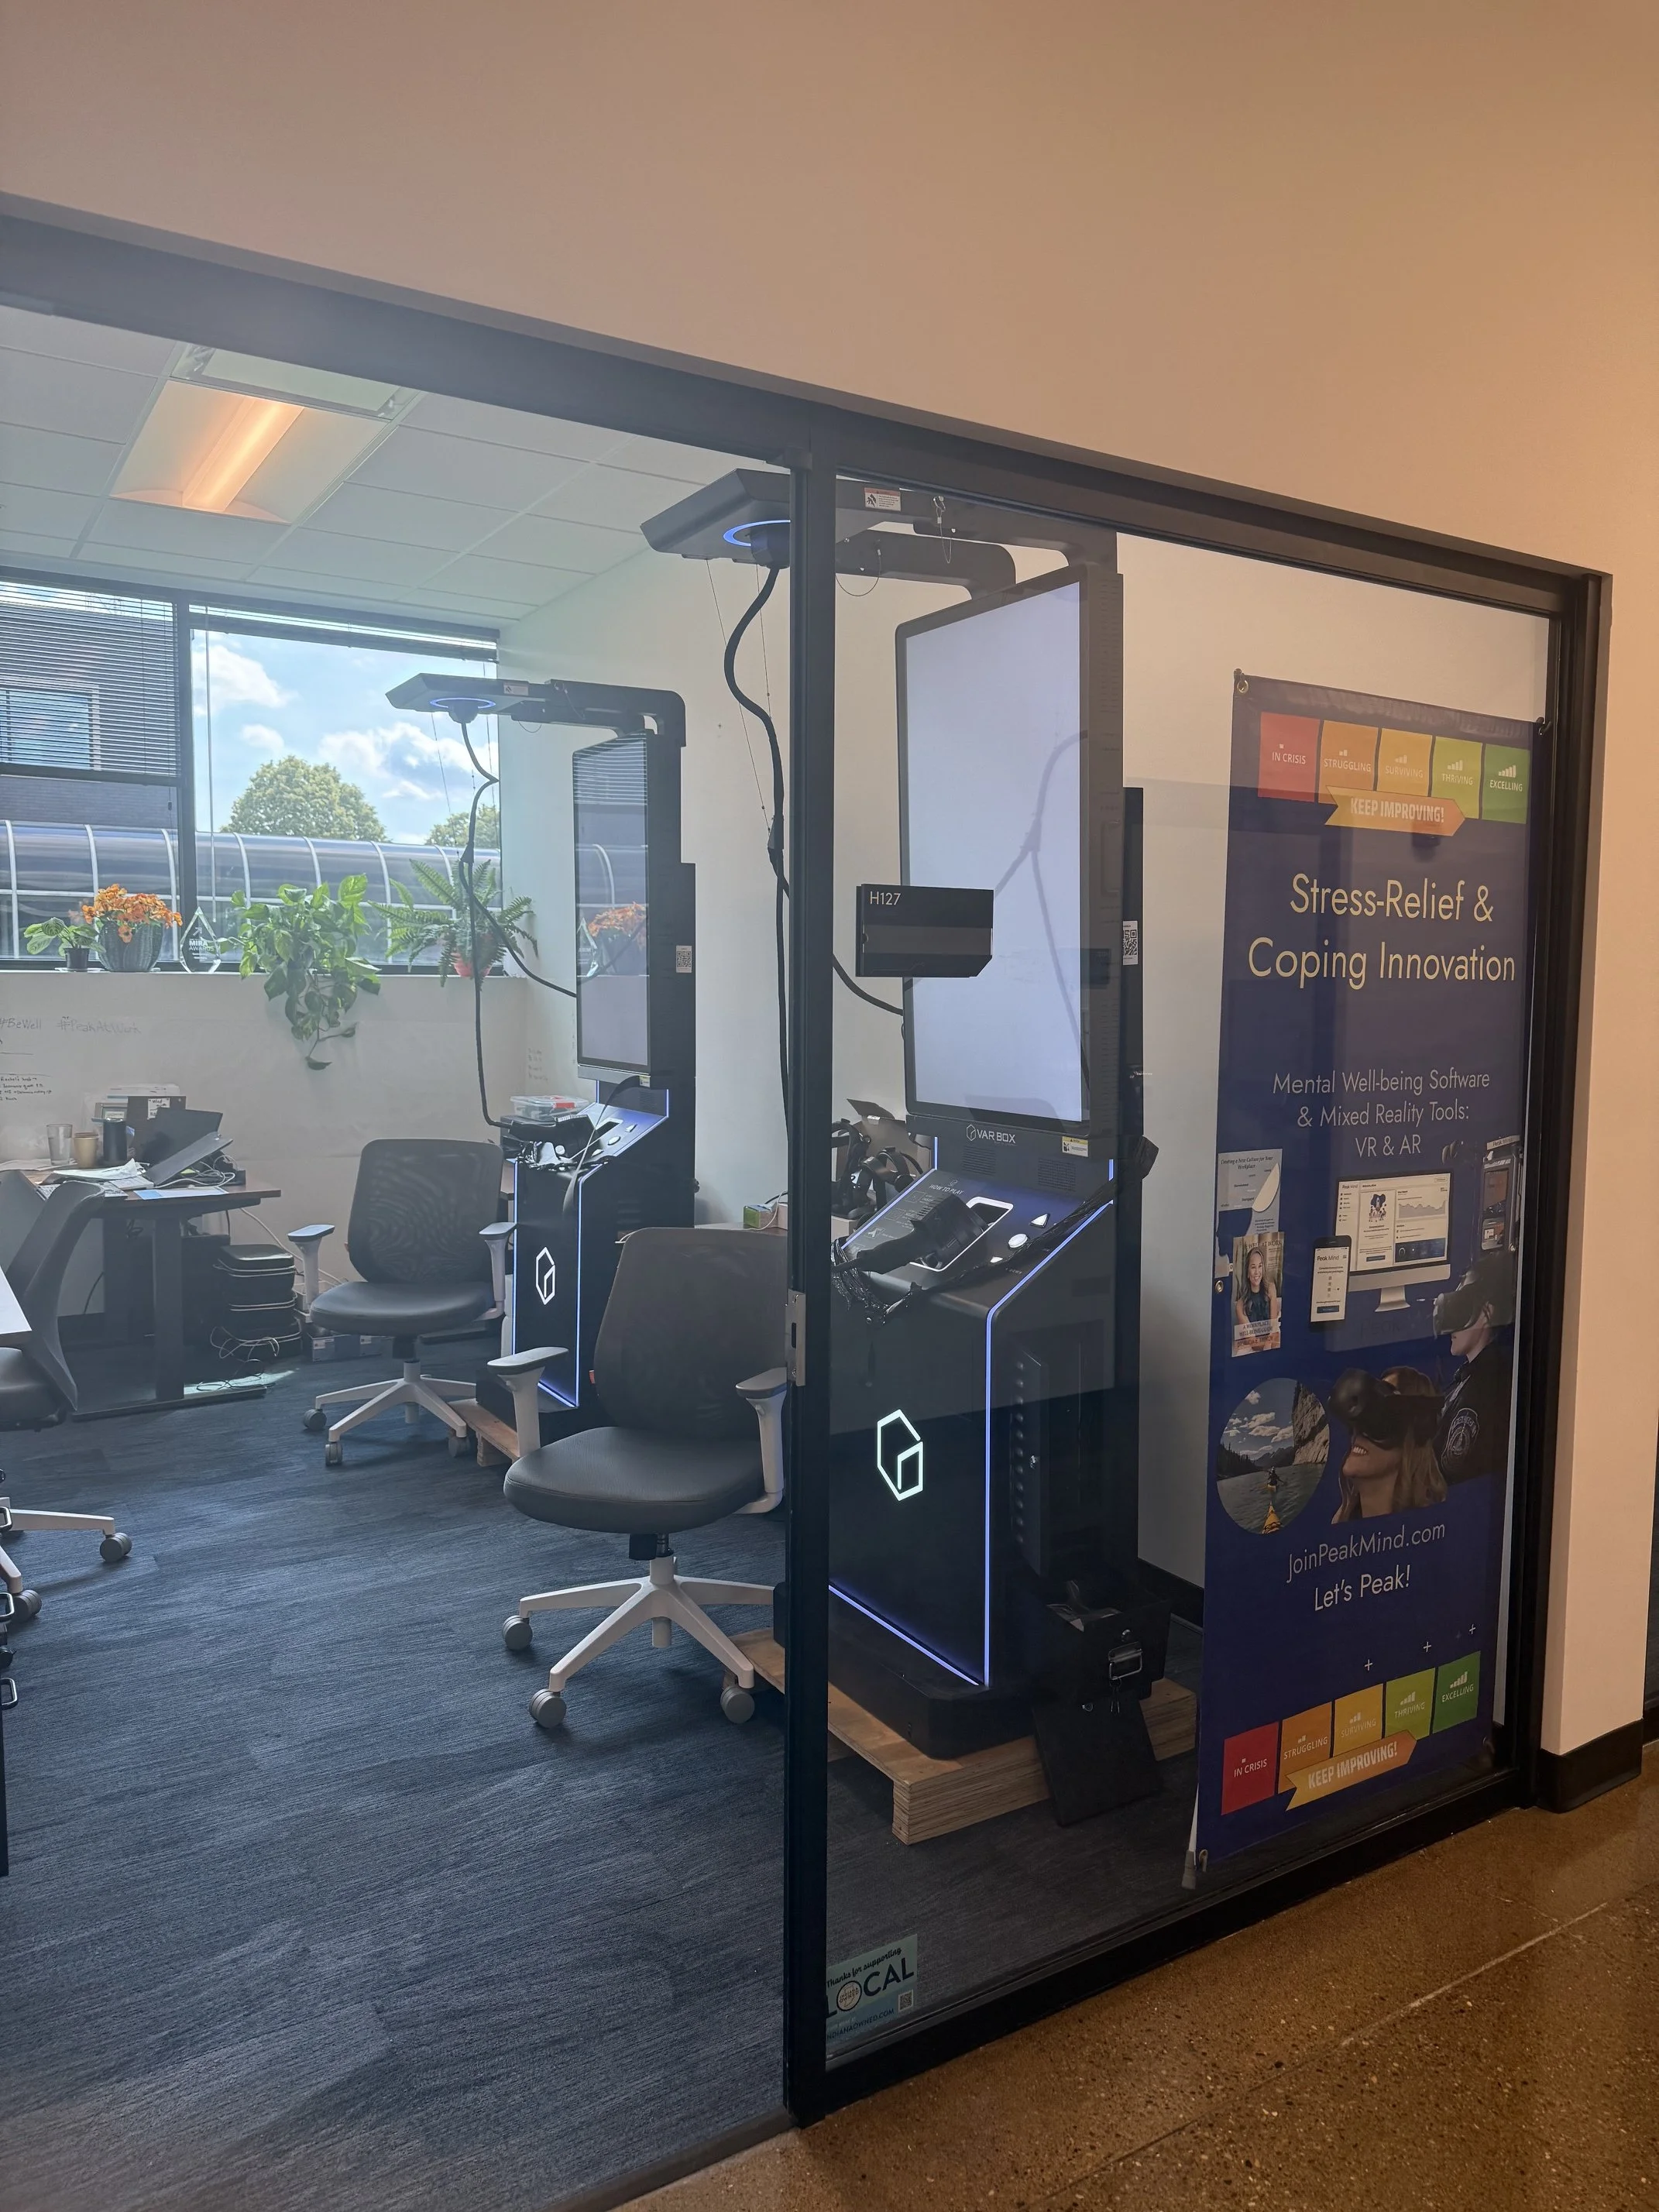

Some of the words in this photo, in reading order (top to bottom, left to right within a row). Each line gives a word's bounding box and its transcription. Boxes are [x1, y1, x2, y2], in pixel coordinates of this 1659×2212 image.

[1272, 751, 1281, 761] IN
[1282, 753, 1307, 764] CRISIS
[1324, 758, 1372, 772] STRUGGLING
[1385, 765, 1424, 778] SURVIVING
[1441, 773, 1473, 785] THRIVING
[1489, 779, 1523, 792] EXCELLING
[1350, 797, 1378, 816] KEEP
[1380, 800, 1444, 823] IMPROVING!
[869, 891, 902, 905] H127
[1290, 873, 1465, 920] Stress-Relief
[1473, 885, 1494, 922] &
[1249, 937, 1367, 990] Coping
[1379, 941, 1515, 981] Innovation
[1273, 1070, 1335, 1094] Mental
[1341, 1068, 1423, 1096] Well-being
[1429, 1066, 1490, 1089] Software
[1297, 1106, 1313, 1128] &
[1320, 1102, 1369, 1127] Mixed
[1376, 1100, 1424, 1127] Reality
[1429, 1098, 1469, 1121] Tools:
[1355, 1136, 1376, 1158] VR
[1382, 1135, 1394, 1156] &
[1400, 1134, 1421, 1155] AR
[1286, 1524, 1445, 1583] JoinPeakMind.com
[1314, 1579, 1352, 1611] Let's
[1360, 1565, 1410, 1598] Peak!
[1441, 1684, 1474, 1702] EXCELLING
[1394, 1702, 1426, 1719] THRIVING
[1341, 1718, 1377, 1738] SURVIVING
[1283, 1736, 1328, 1760] STRUGGLING
[1234, 1767, 1242, 1778] IN
[1244, 1758, 1268, 1774] CRISIS
[1308, 1766, 1334, 1789] KEEP
[1337, 1740, 1398, 1778] IMPROVING!
[826, 1971, 851, 1988] Thanks
[853, 1967, 862, 1978] for
[863, 1947, 902, 1970] supporting
[826, 2008, 895, 2040] NDIANAOWNED.COM
